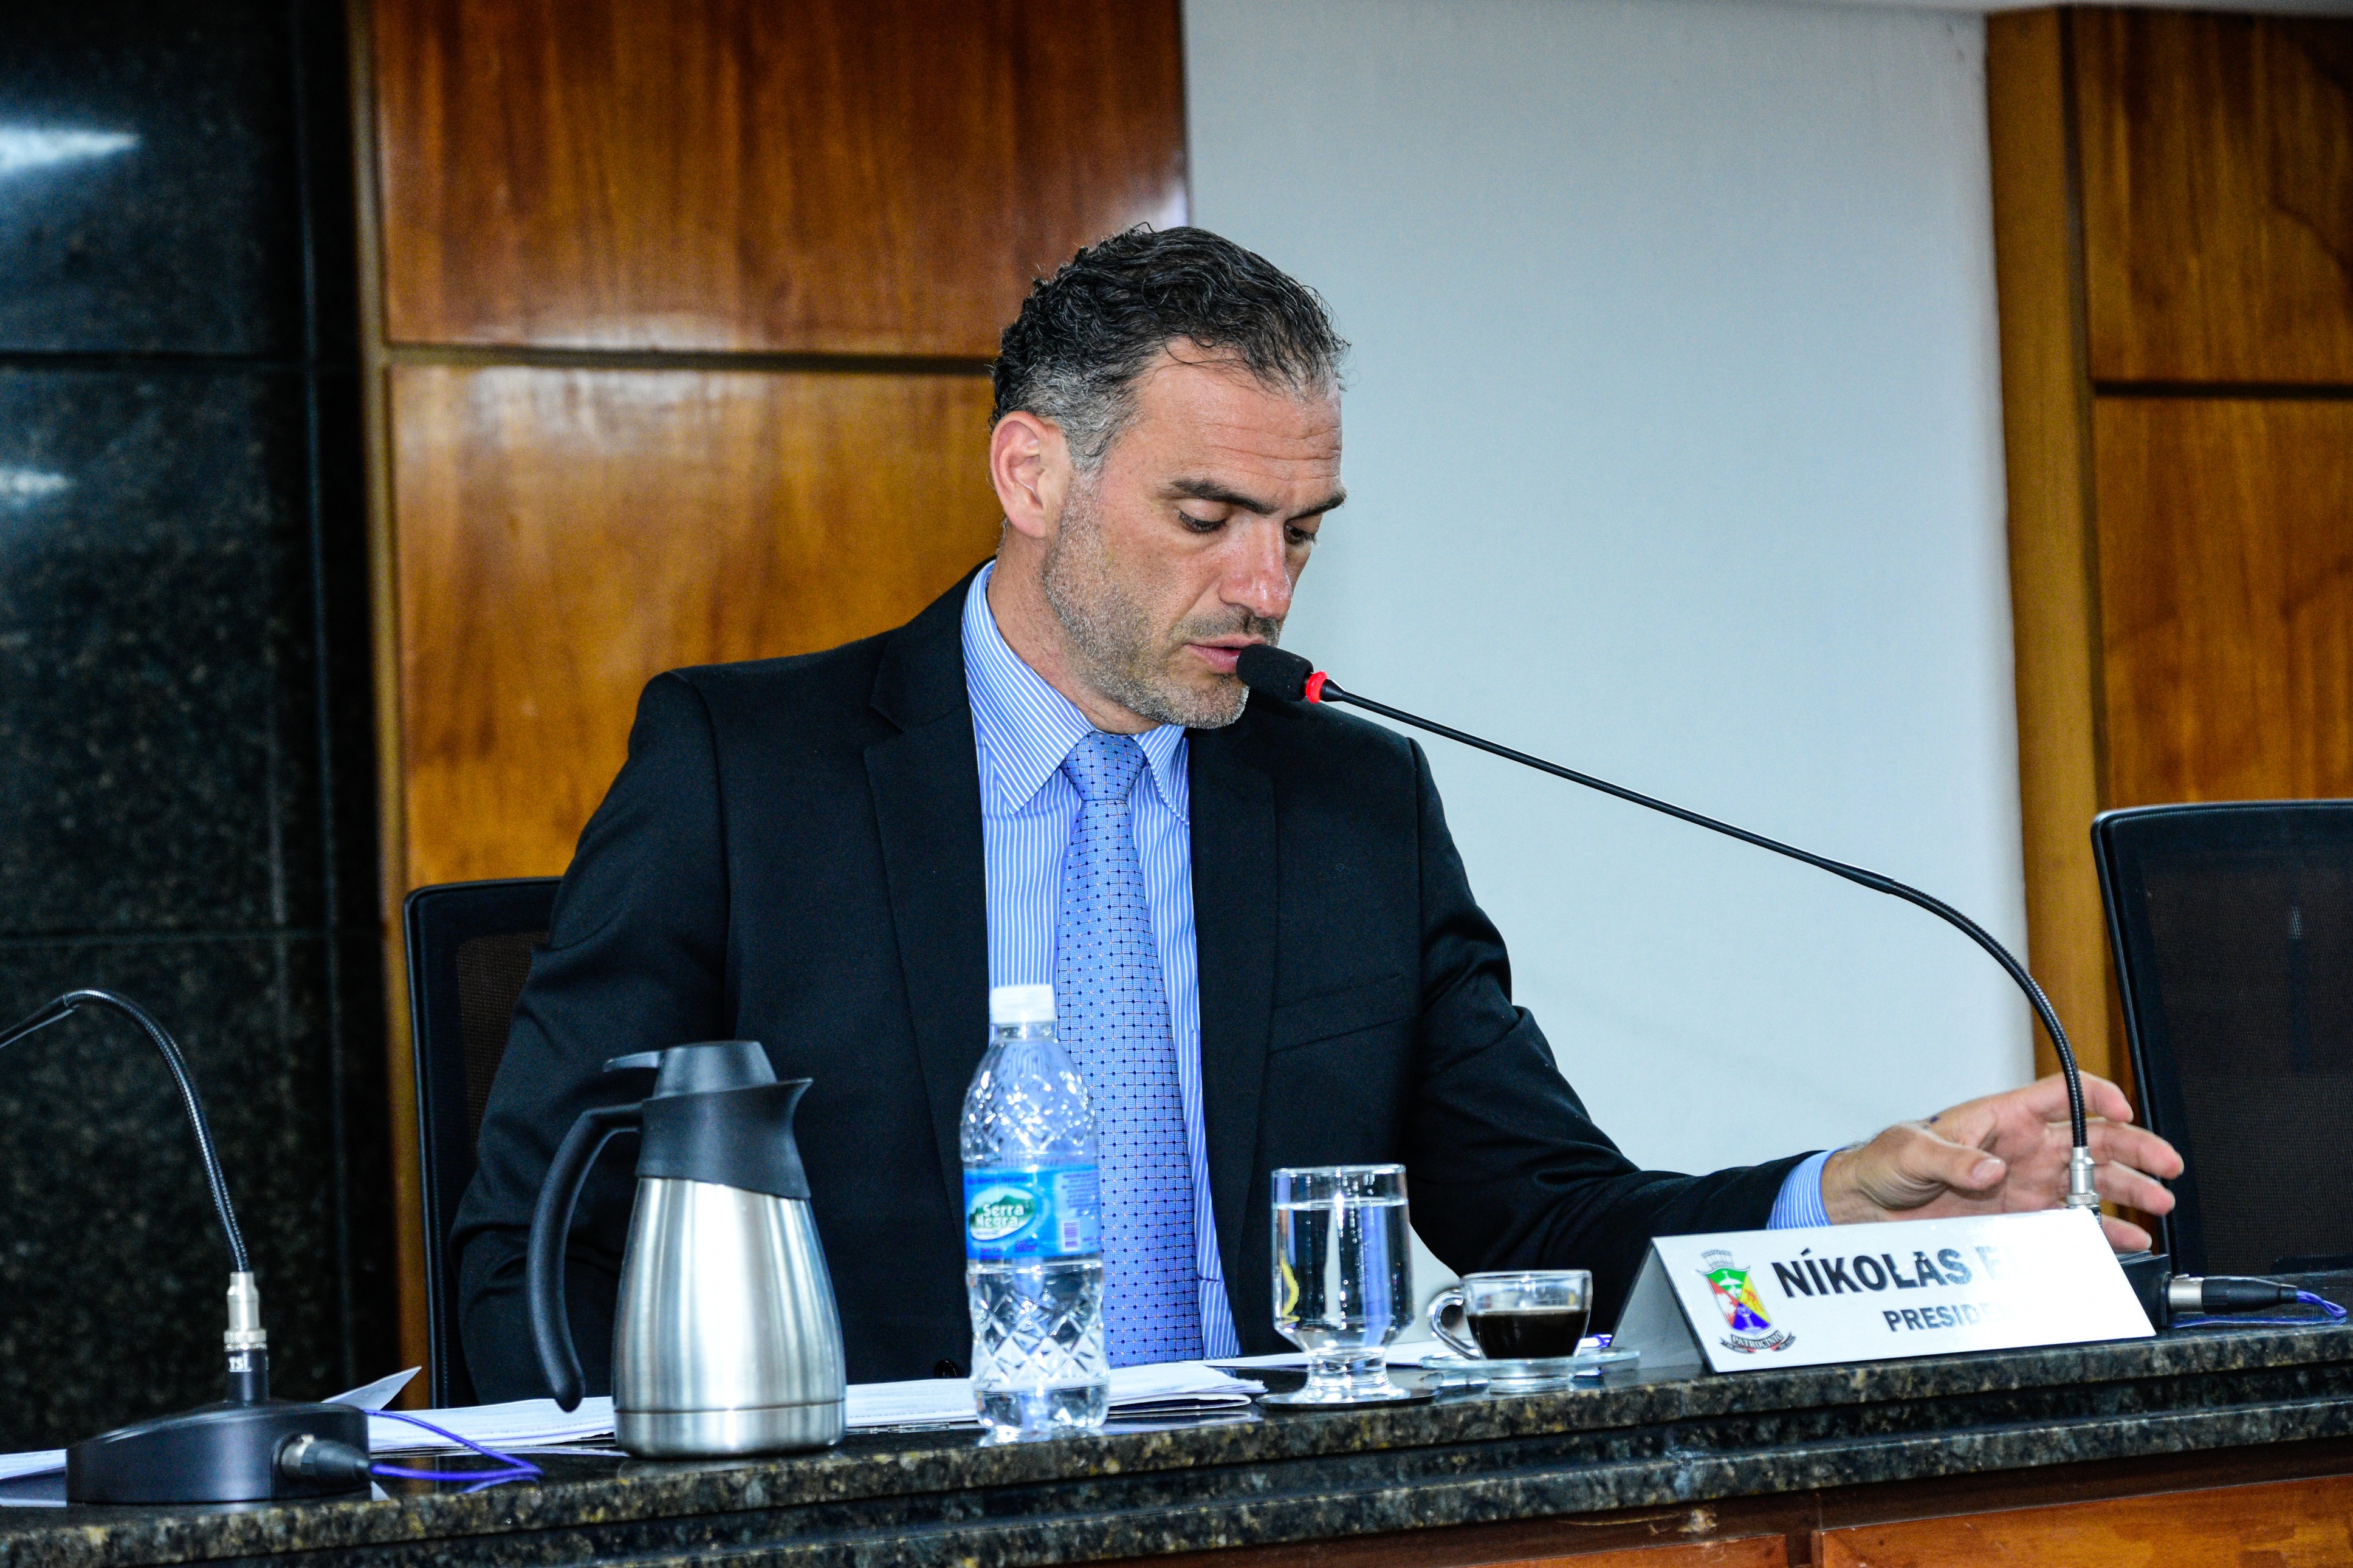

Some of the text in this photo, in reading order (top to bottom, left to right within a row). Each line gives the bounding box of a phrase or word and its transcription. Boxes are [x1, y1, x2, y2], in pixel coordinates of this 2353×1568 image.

[983, 1203, 1025, 1217] Serra
[975, 1215, 1019, 1230] Negra
[1771, 1247, 1973, 1298] NÍKOLAS
